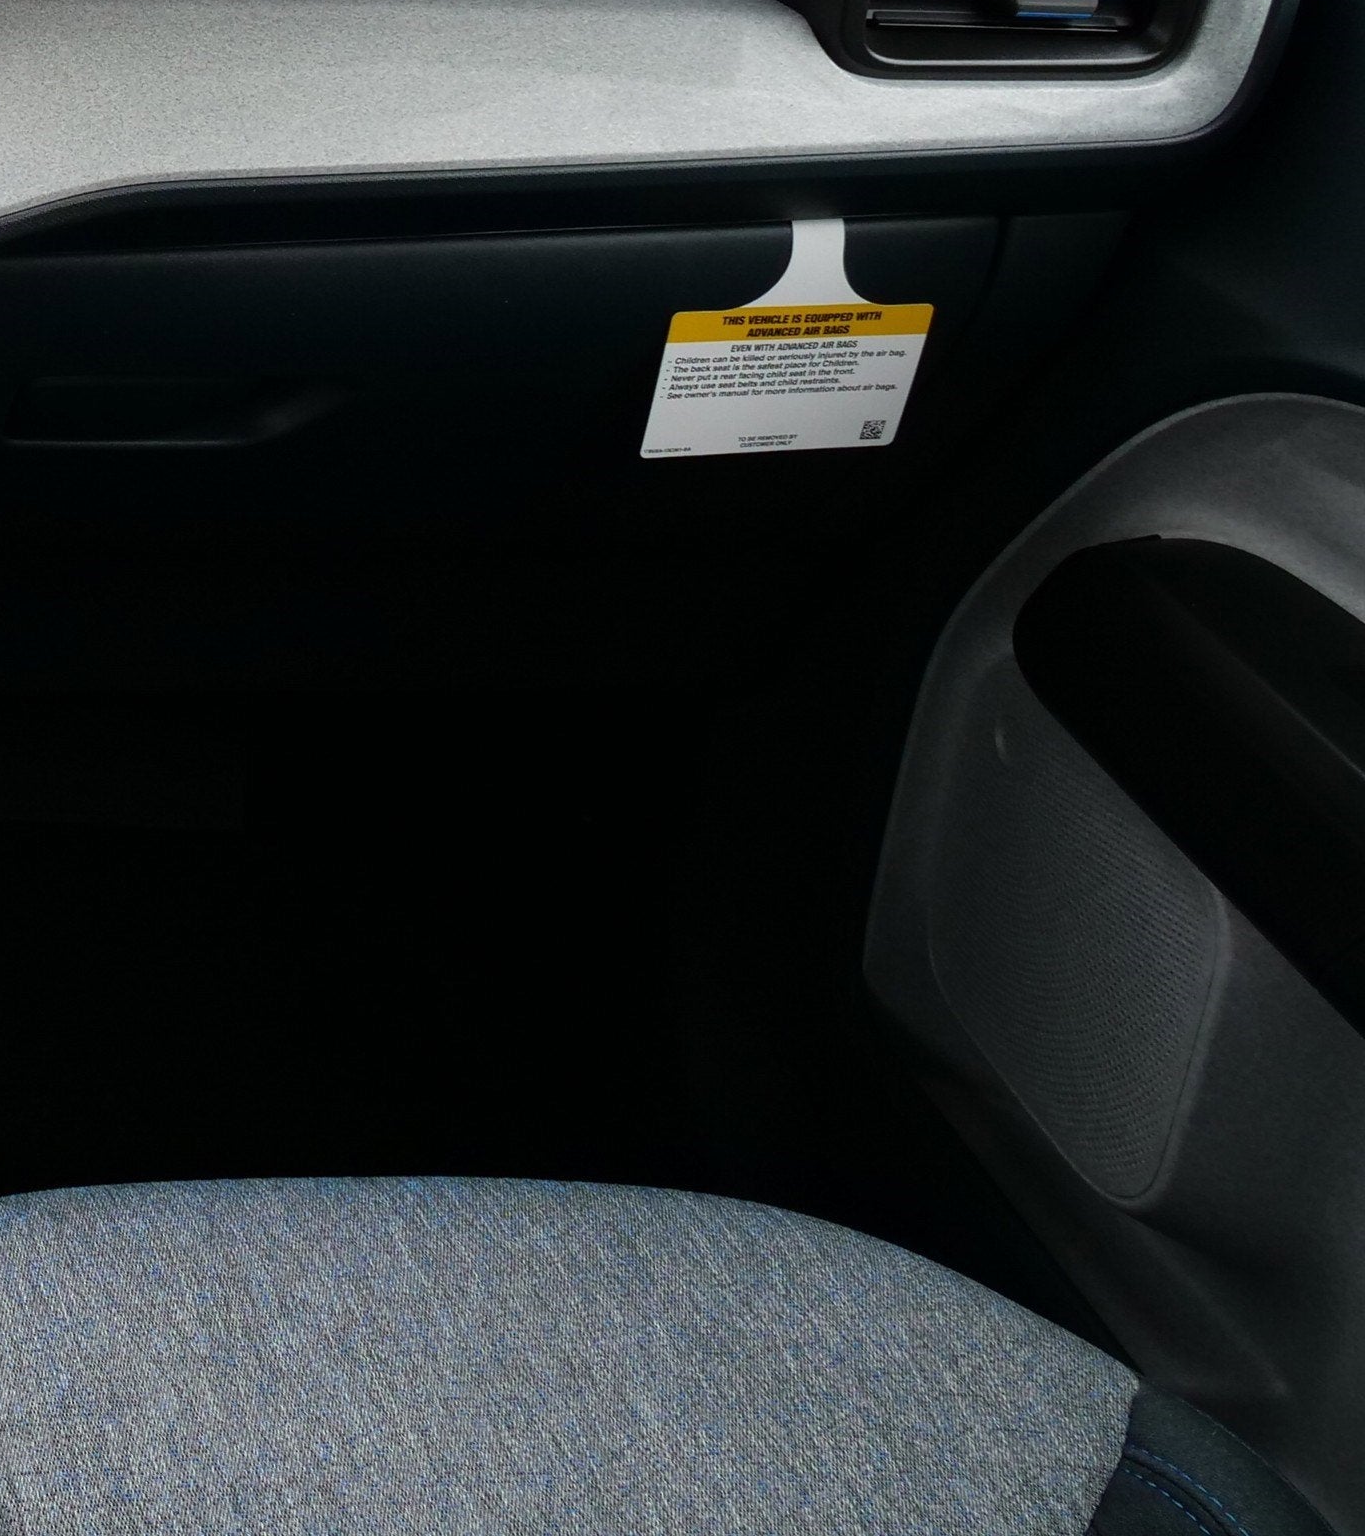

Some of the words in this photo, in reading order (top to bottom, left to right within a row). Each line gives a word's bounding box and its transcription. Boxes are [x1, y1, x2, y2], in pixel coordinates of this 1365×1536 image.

[723, 316, 746, 325] THIS
[749, 314, 790, 324] VEHICLE
[792, 314, 802, 323] IS
[804, 312, 853, 322] EQUIPPED
[856, 311, 882, 321] WITH
[747, 326, 801, 337] ADVANCED
[803, 326, 821, 336] AIR
[823, 325, 850, 334] BAGS
[730, 344, 751, 352] EVEN
[754, 343, 775, 351] WITH
[777, 342, 819, 351] ADVANCED
[821, 341, 835, 349] AIR
[837, 340, 858, 348] BAGS
[675, 357, 711, 365] Children
[742, 354, 765, 362] killed
[777, 353, 816, 361] seriously
[818, 352, 848, 360] injured
[849, 351, 859, 359] by
[757, 362, 782, 370] safest
[784, 362, 807, 370] place
[697, 374, 711, 382] put
[739, 371, 764, 381] facing
[788, 369, 806, 377] seat
[667, 392, 683, 400] See
[684, 390, 717, 399] owner's
[719, 389, 749, 397] manual
[751, 388, 763, 396] for
[788, 386, 835, 394] information
[837, 384, 861, 392] about
[669, 384, 699, 392] Always
